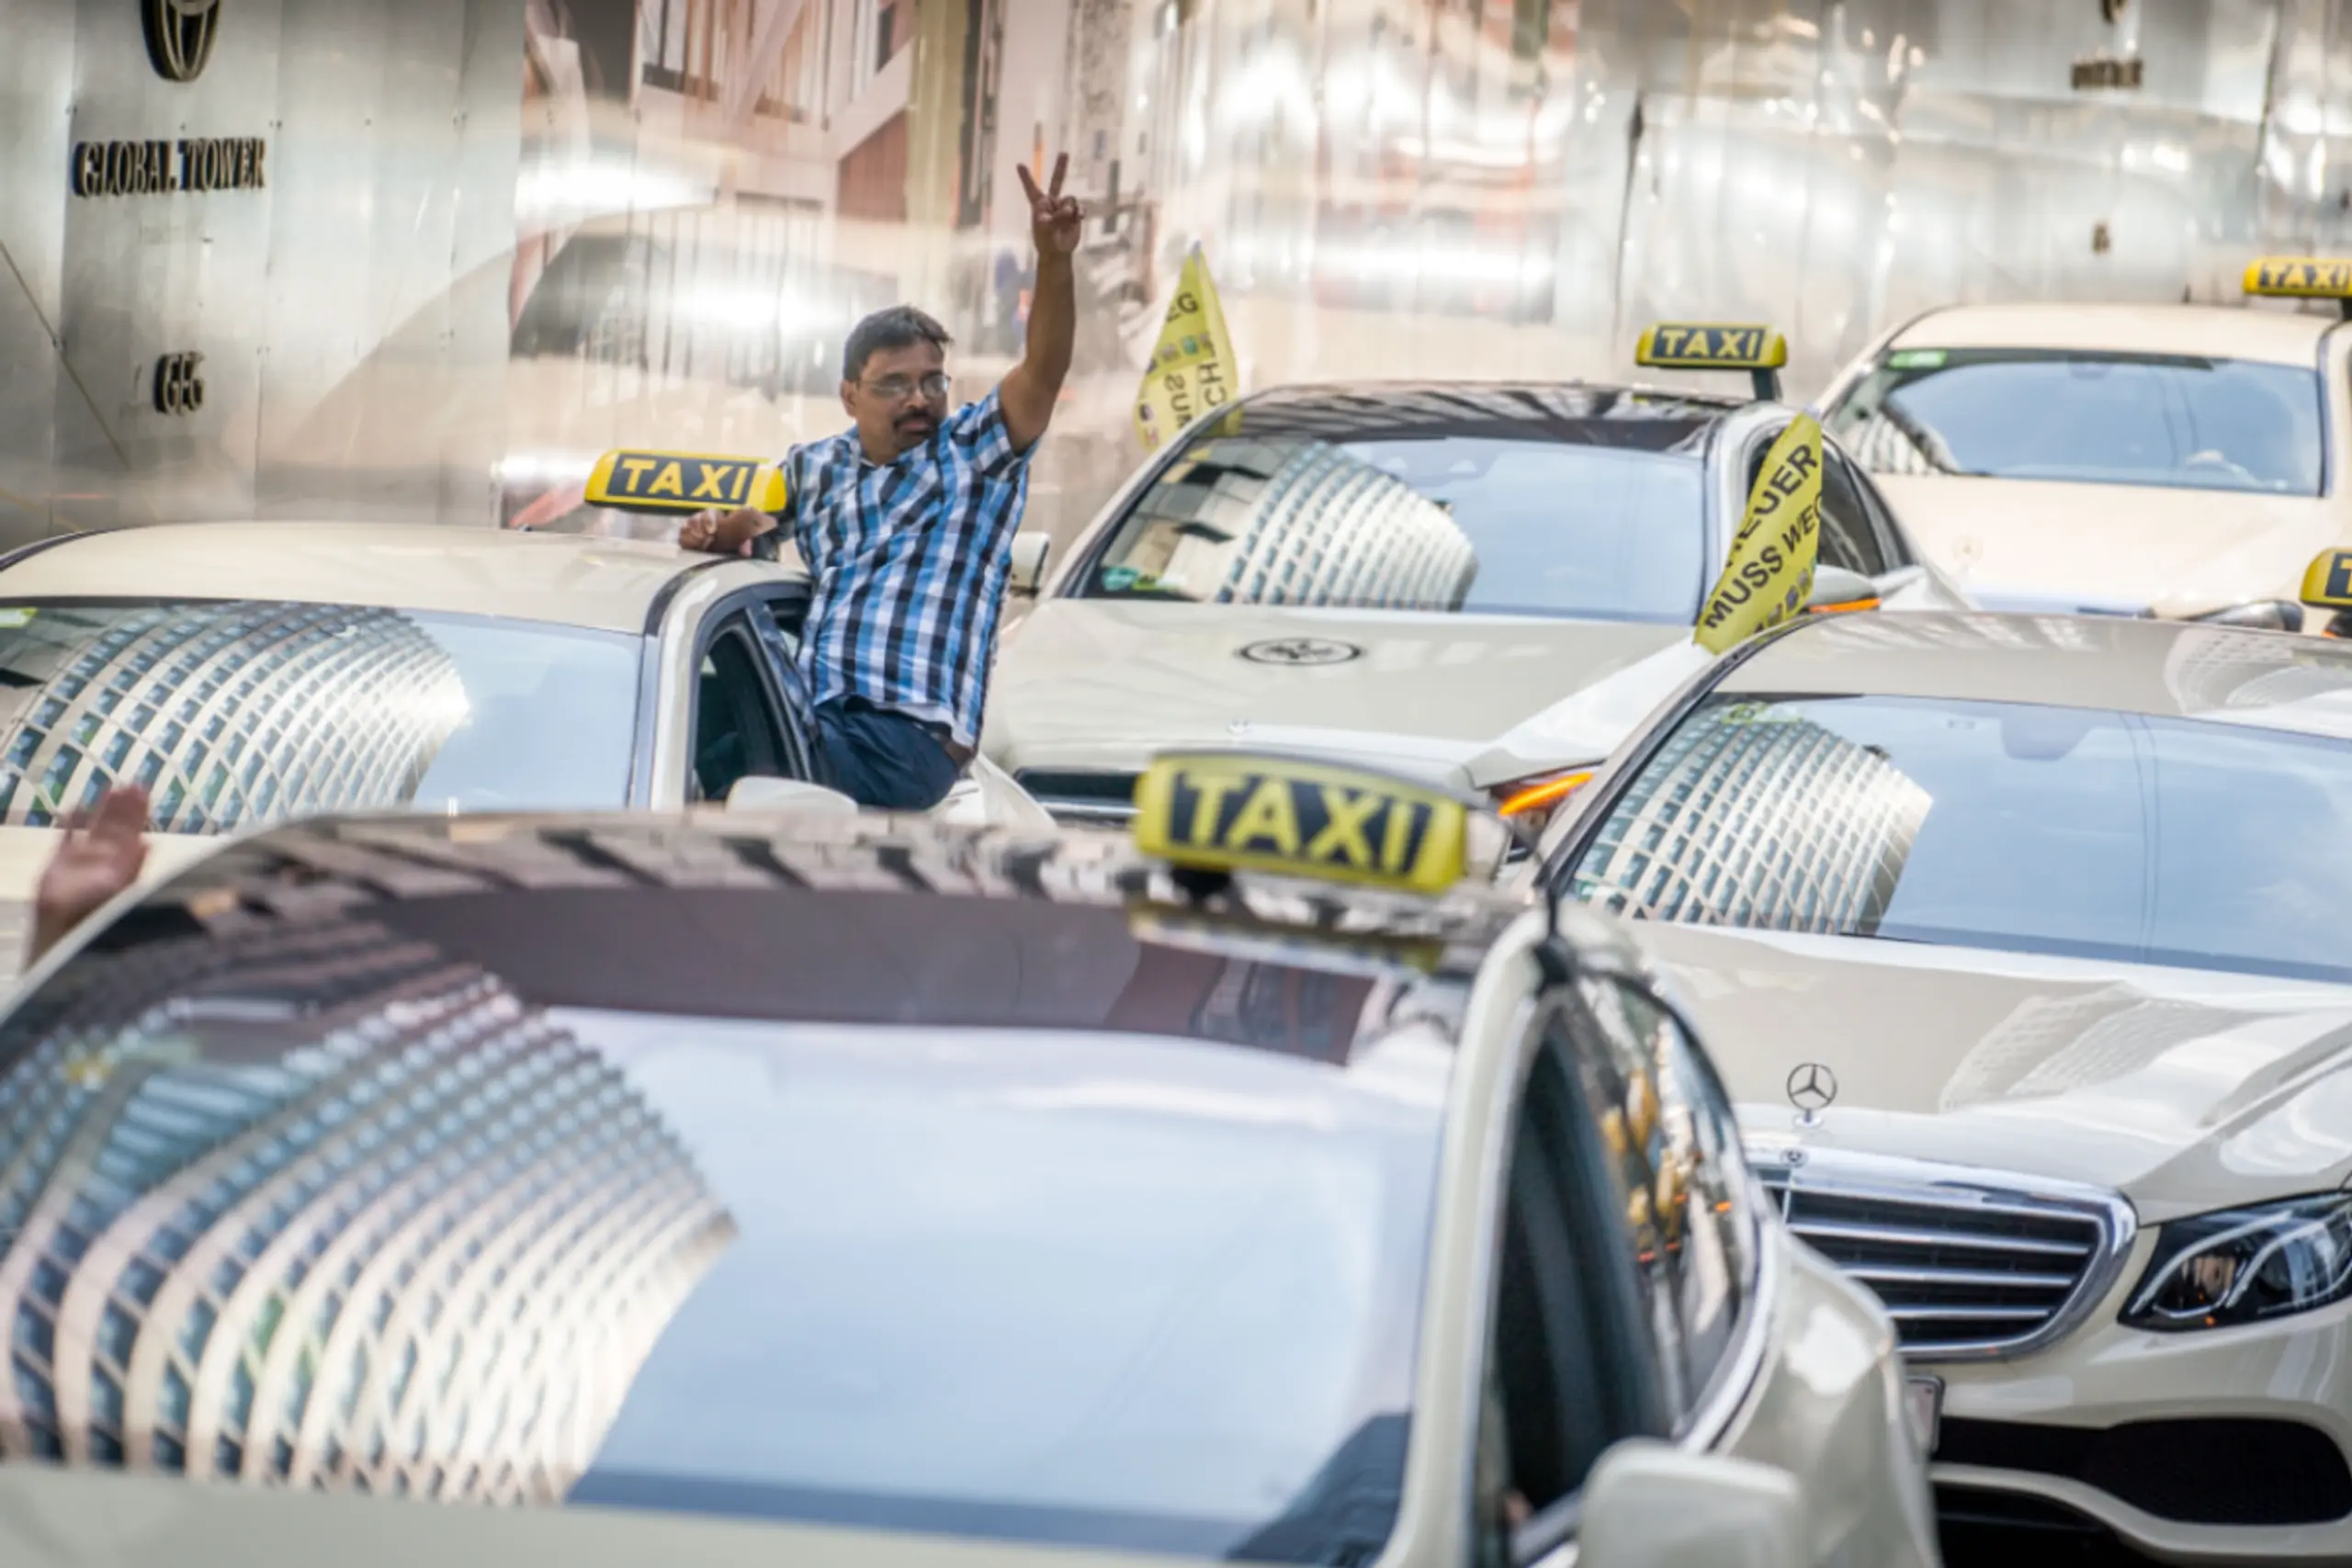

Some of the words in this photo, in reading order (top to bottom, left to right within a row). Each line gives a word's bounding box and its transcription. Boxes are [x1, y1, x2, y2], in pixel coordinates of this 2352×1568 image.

[71, 140, 178, 197] GLOBAL
[178, 138, 266, 191] TOWER
[2262, 262, 2347, 288] TAXI
[1659, 328, 1760, 358] TAXI
[621, 457, 751, 501] TAXI
[1702, 546, 1784, 630] MUSS
[1182, 773, 1411, 876] TAXI
